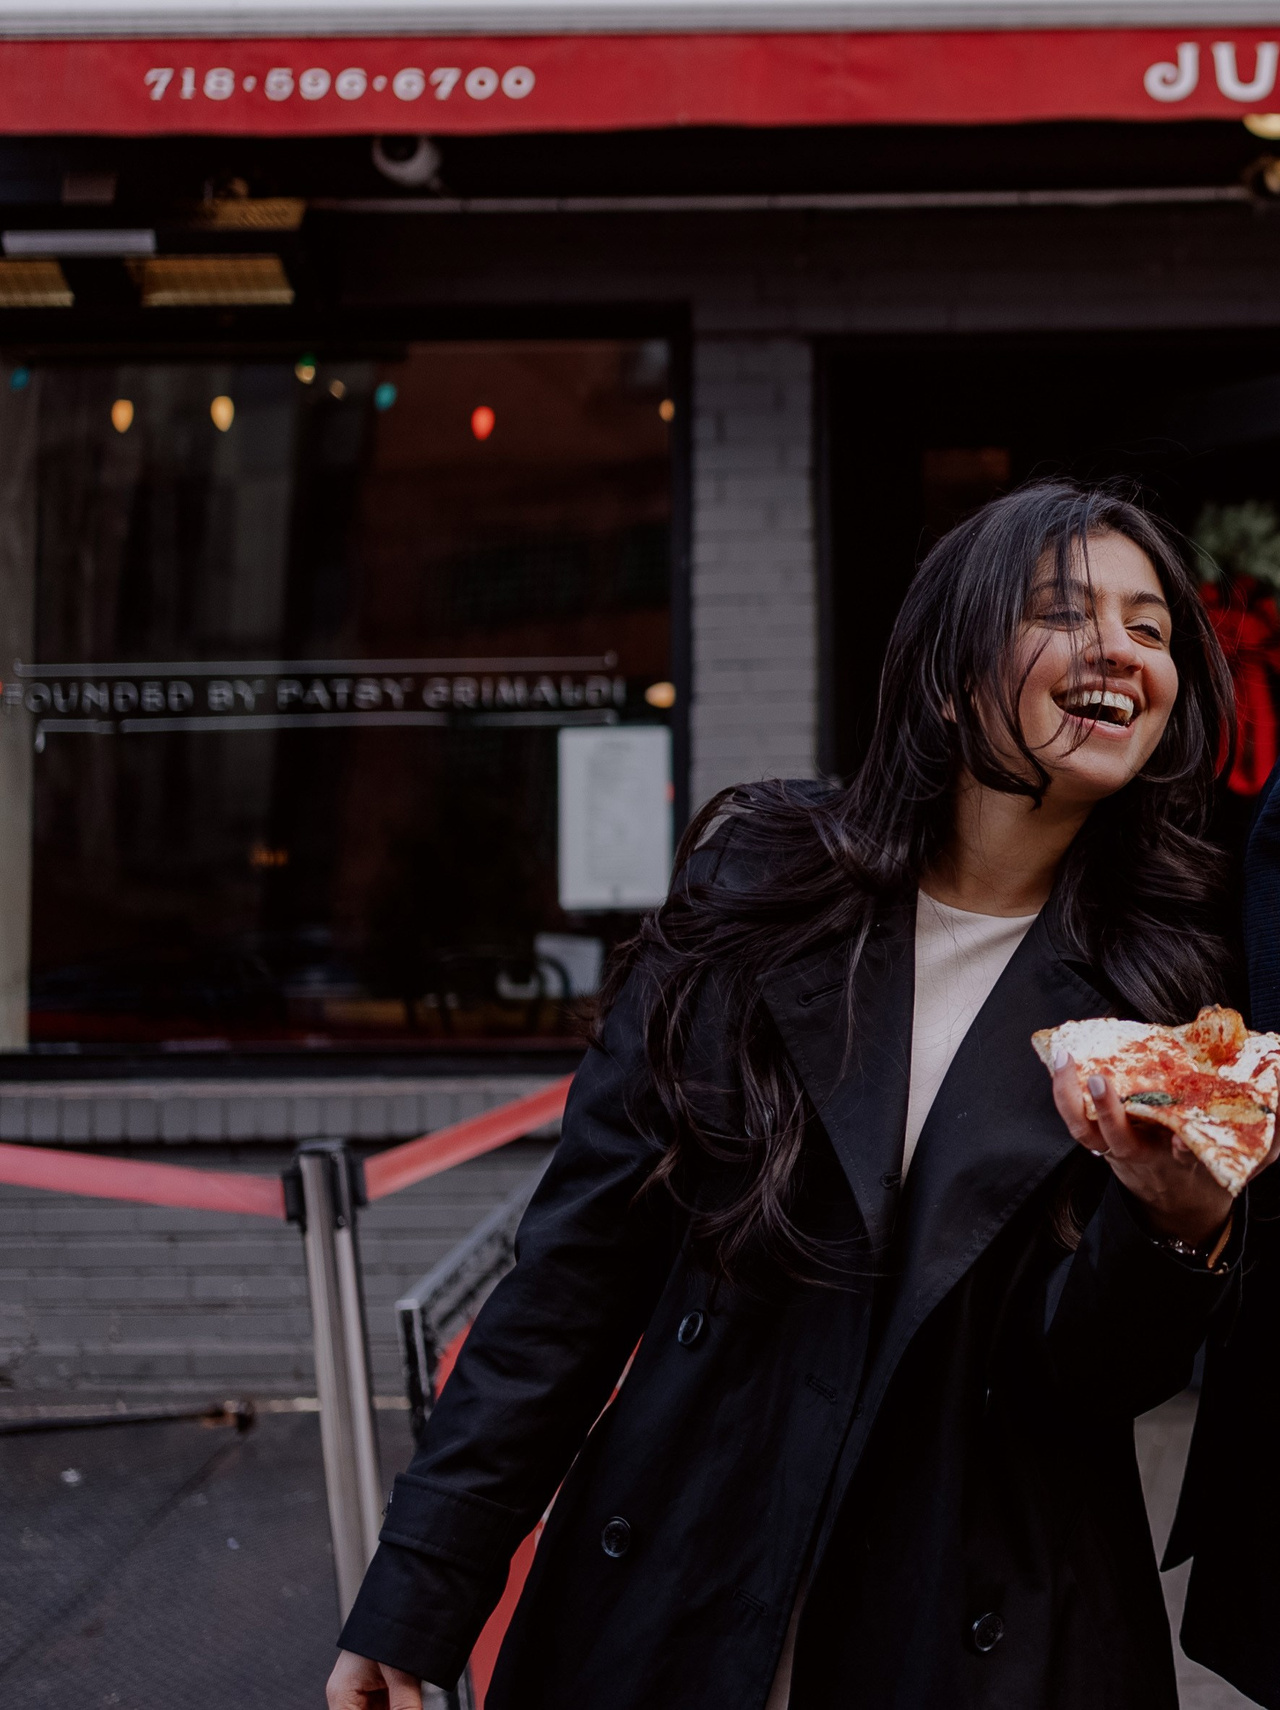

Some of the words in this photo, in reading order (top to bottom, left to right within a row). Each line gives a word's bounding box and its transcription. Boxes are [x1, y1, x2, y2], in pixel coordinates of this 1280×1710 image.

[4, 681, 195, 714] FOUNDED
[207, 680, 265, 711] BY
[276, 677, 414, 711] PATSY
[422, 675, 626, 710] GRIMALDI
